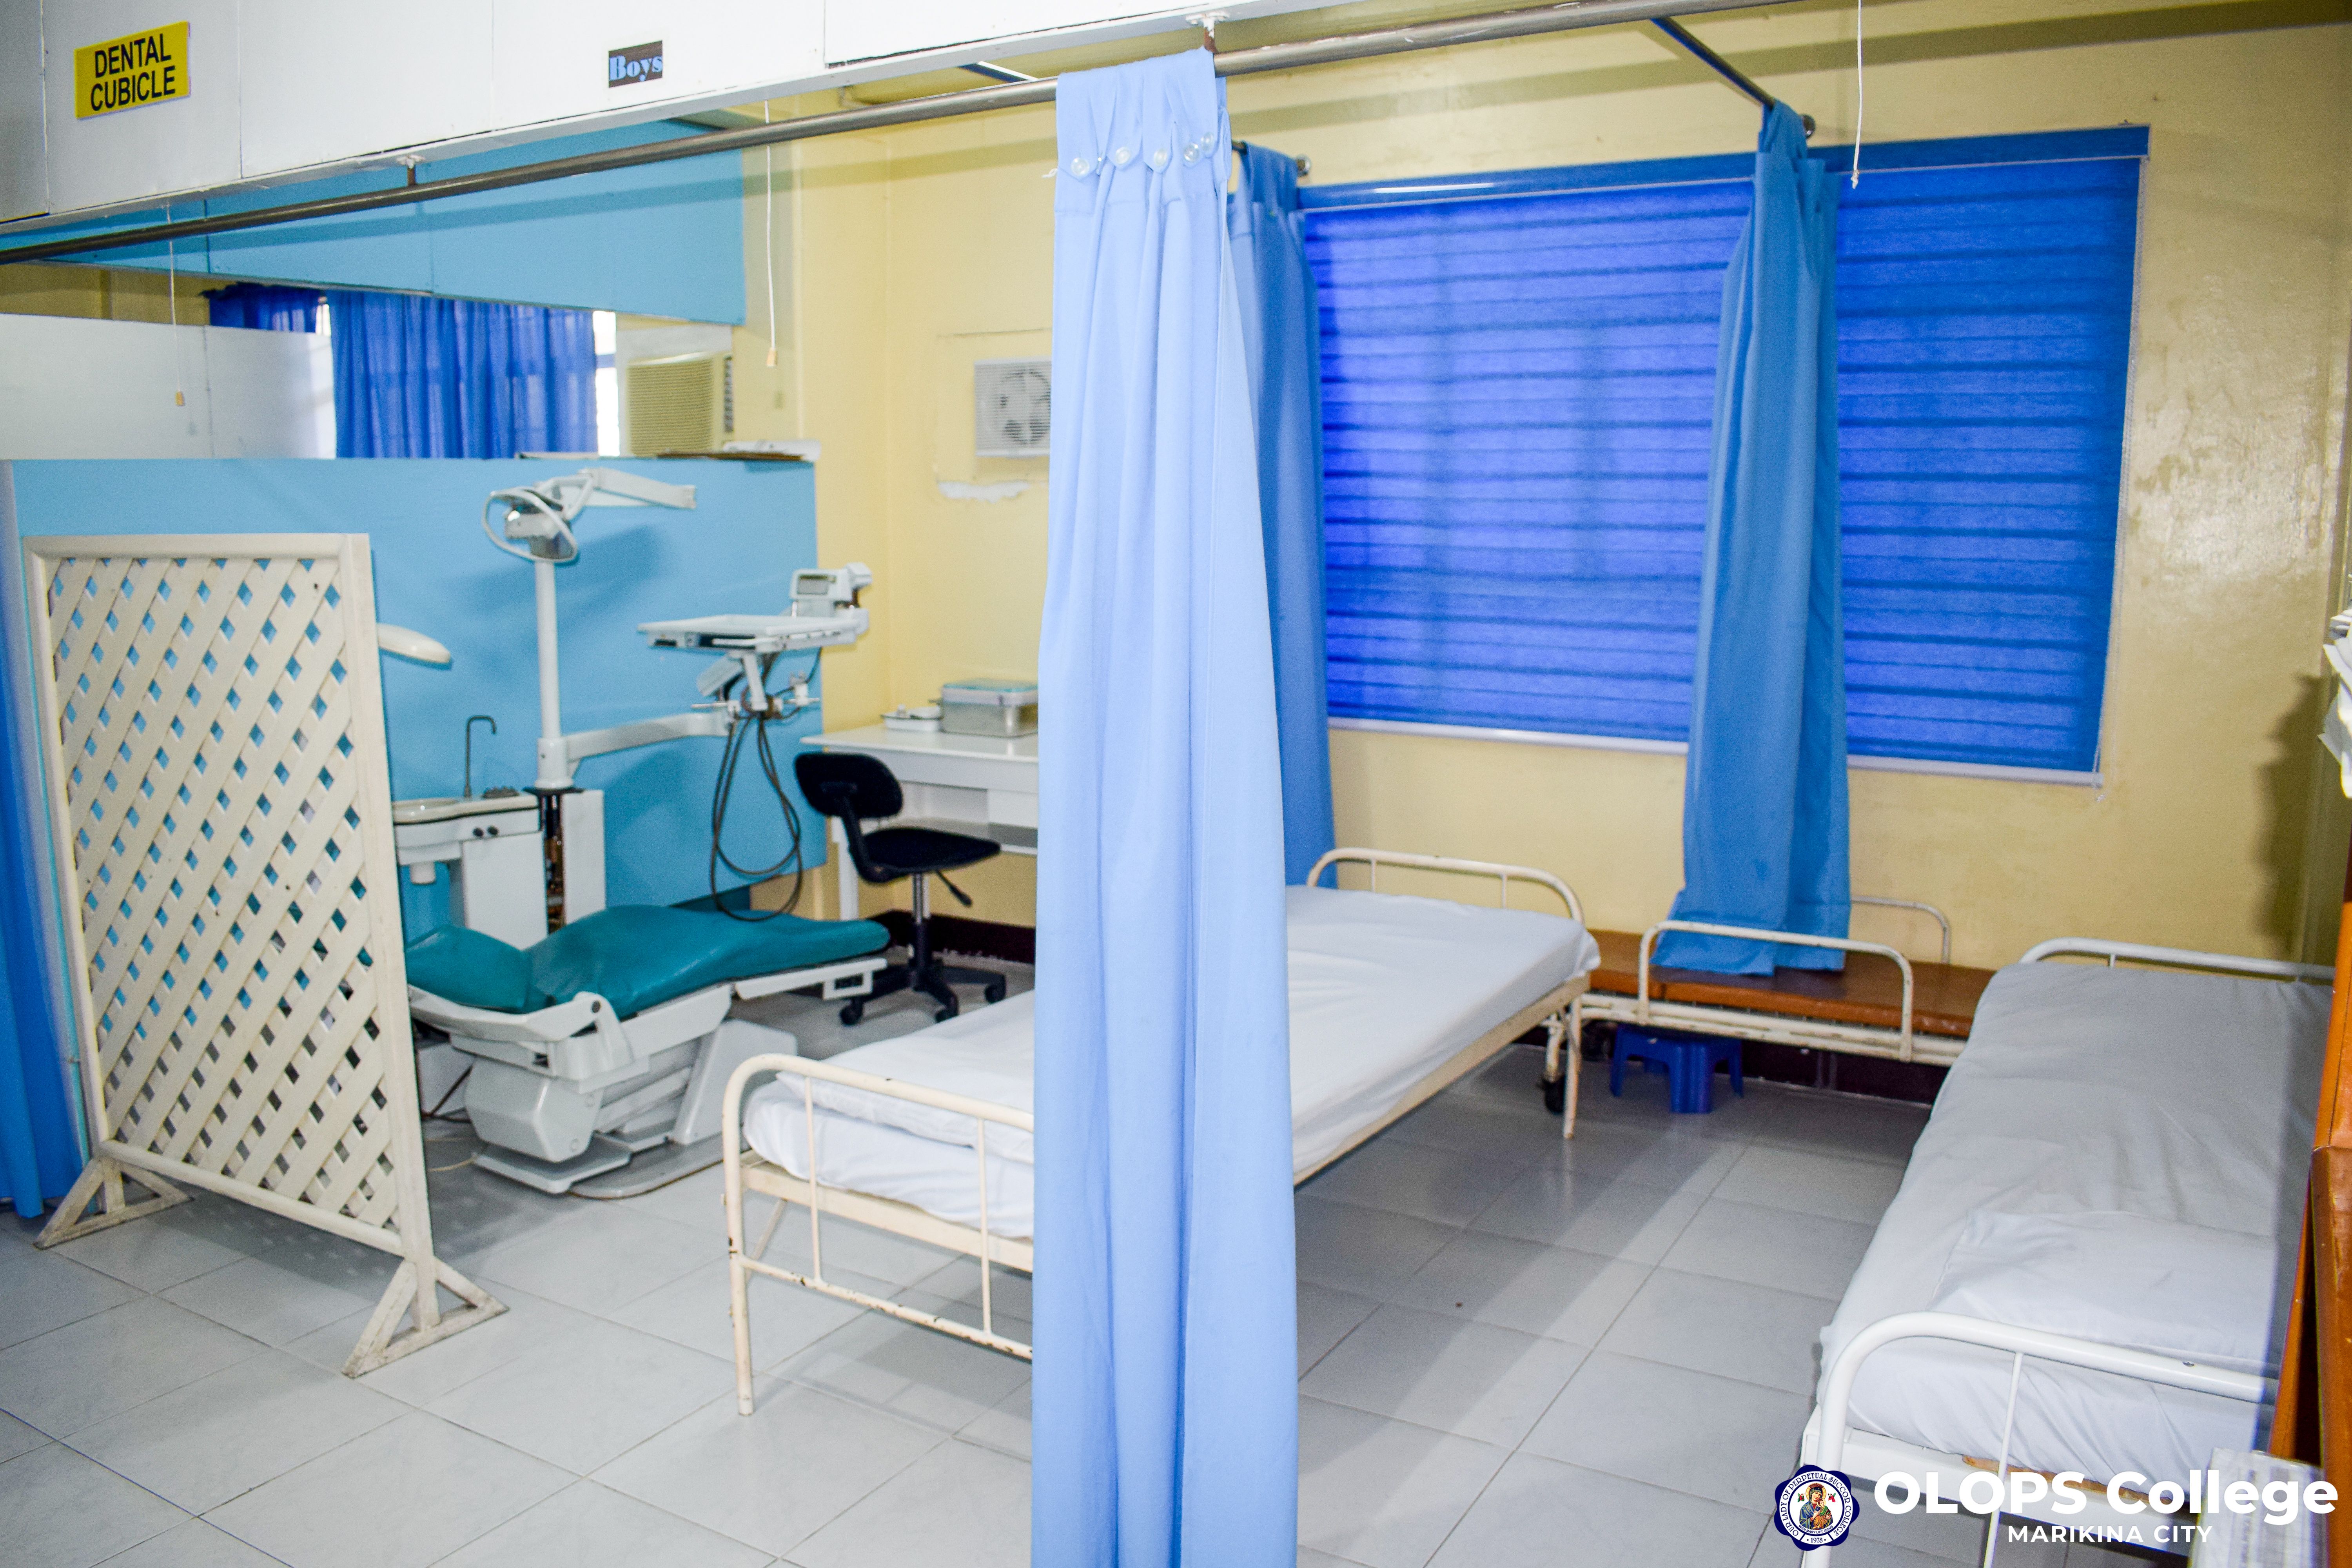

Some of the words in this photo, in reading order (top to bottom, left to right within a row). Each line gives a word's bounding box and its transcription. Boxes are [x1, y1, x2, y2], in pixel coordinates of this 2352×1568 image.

[94, 33, 171, 78] DENTAL
[609, 54, 663, 82] Boys
[90, 65, 176, 112] CUBICLE
